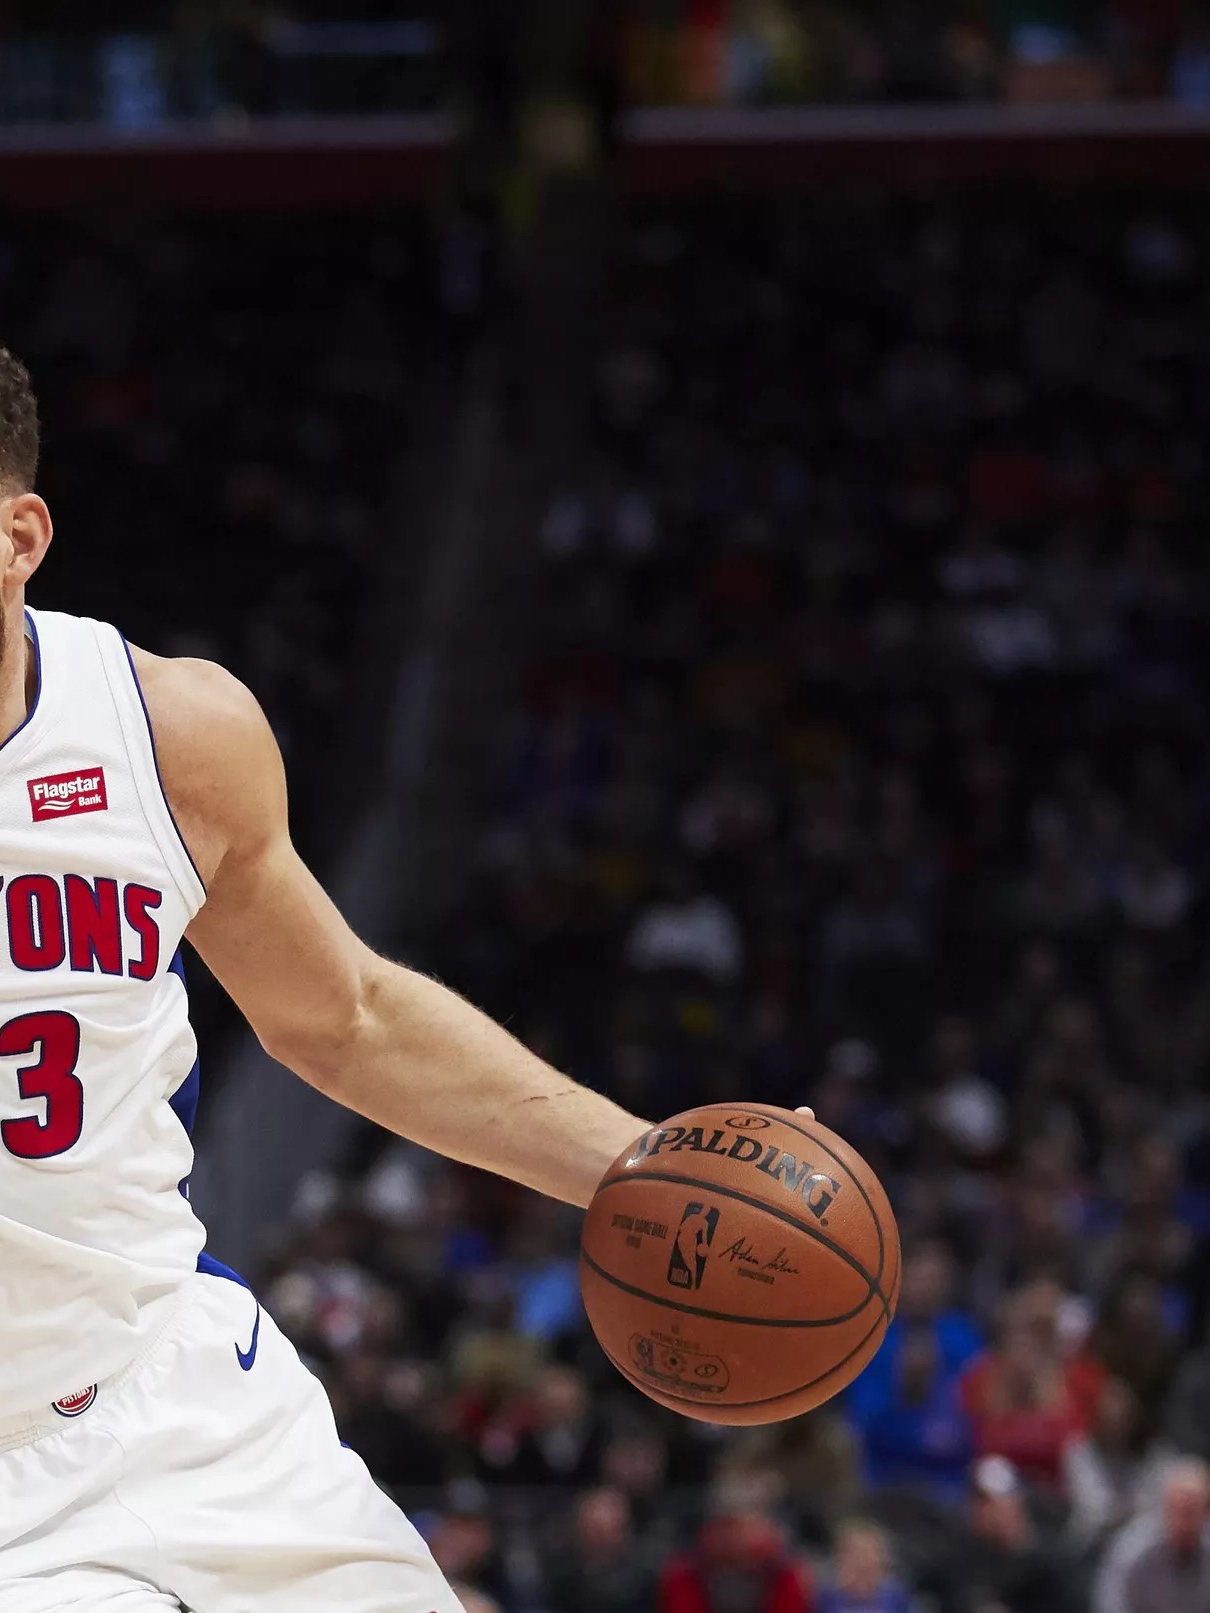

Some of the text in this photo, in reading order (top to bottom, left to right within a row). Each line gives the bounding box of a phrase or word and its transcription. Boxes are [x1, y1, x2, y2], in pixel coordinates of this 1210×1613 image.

[33, 776, 100, 800] Flagstar
[78, 794, 103, 807] Bank
[61, 1387, 91, 1406] PISTONS
